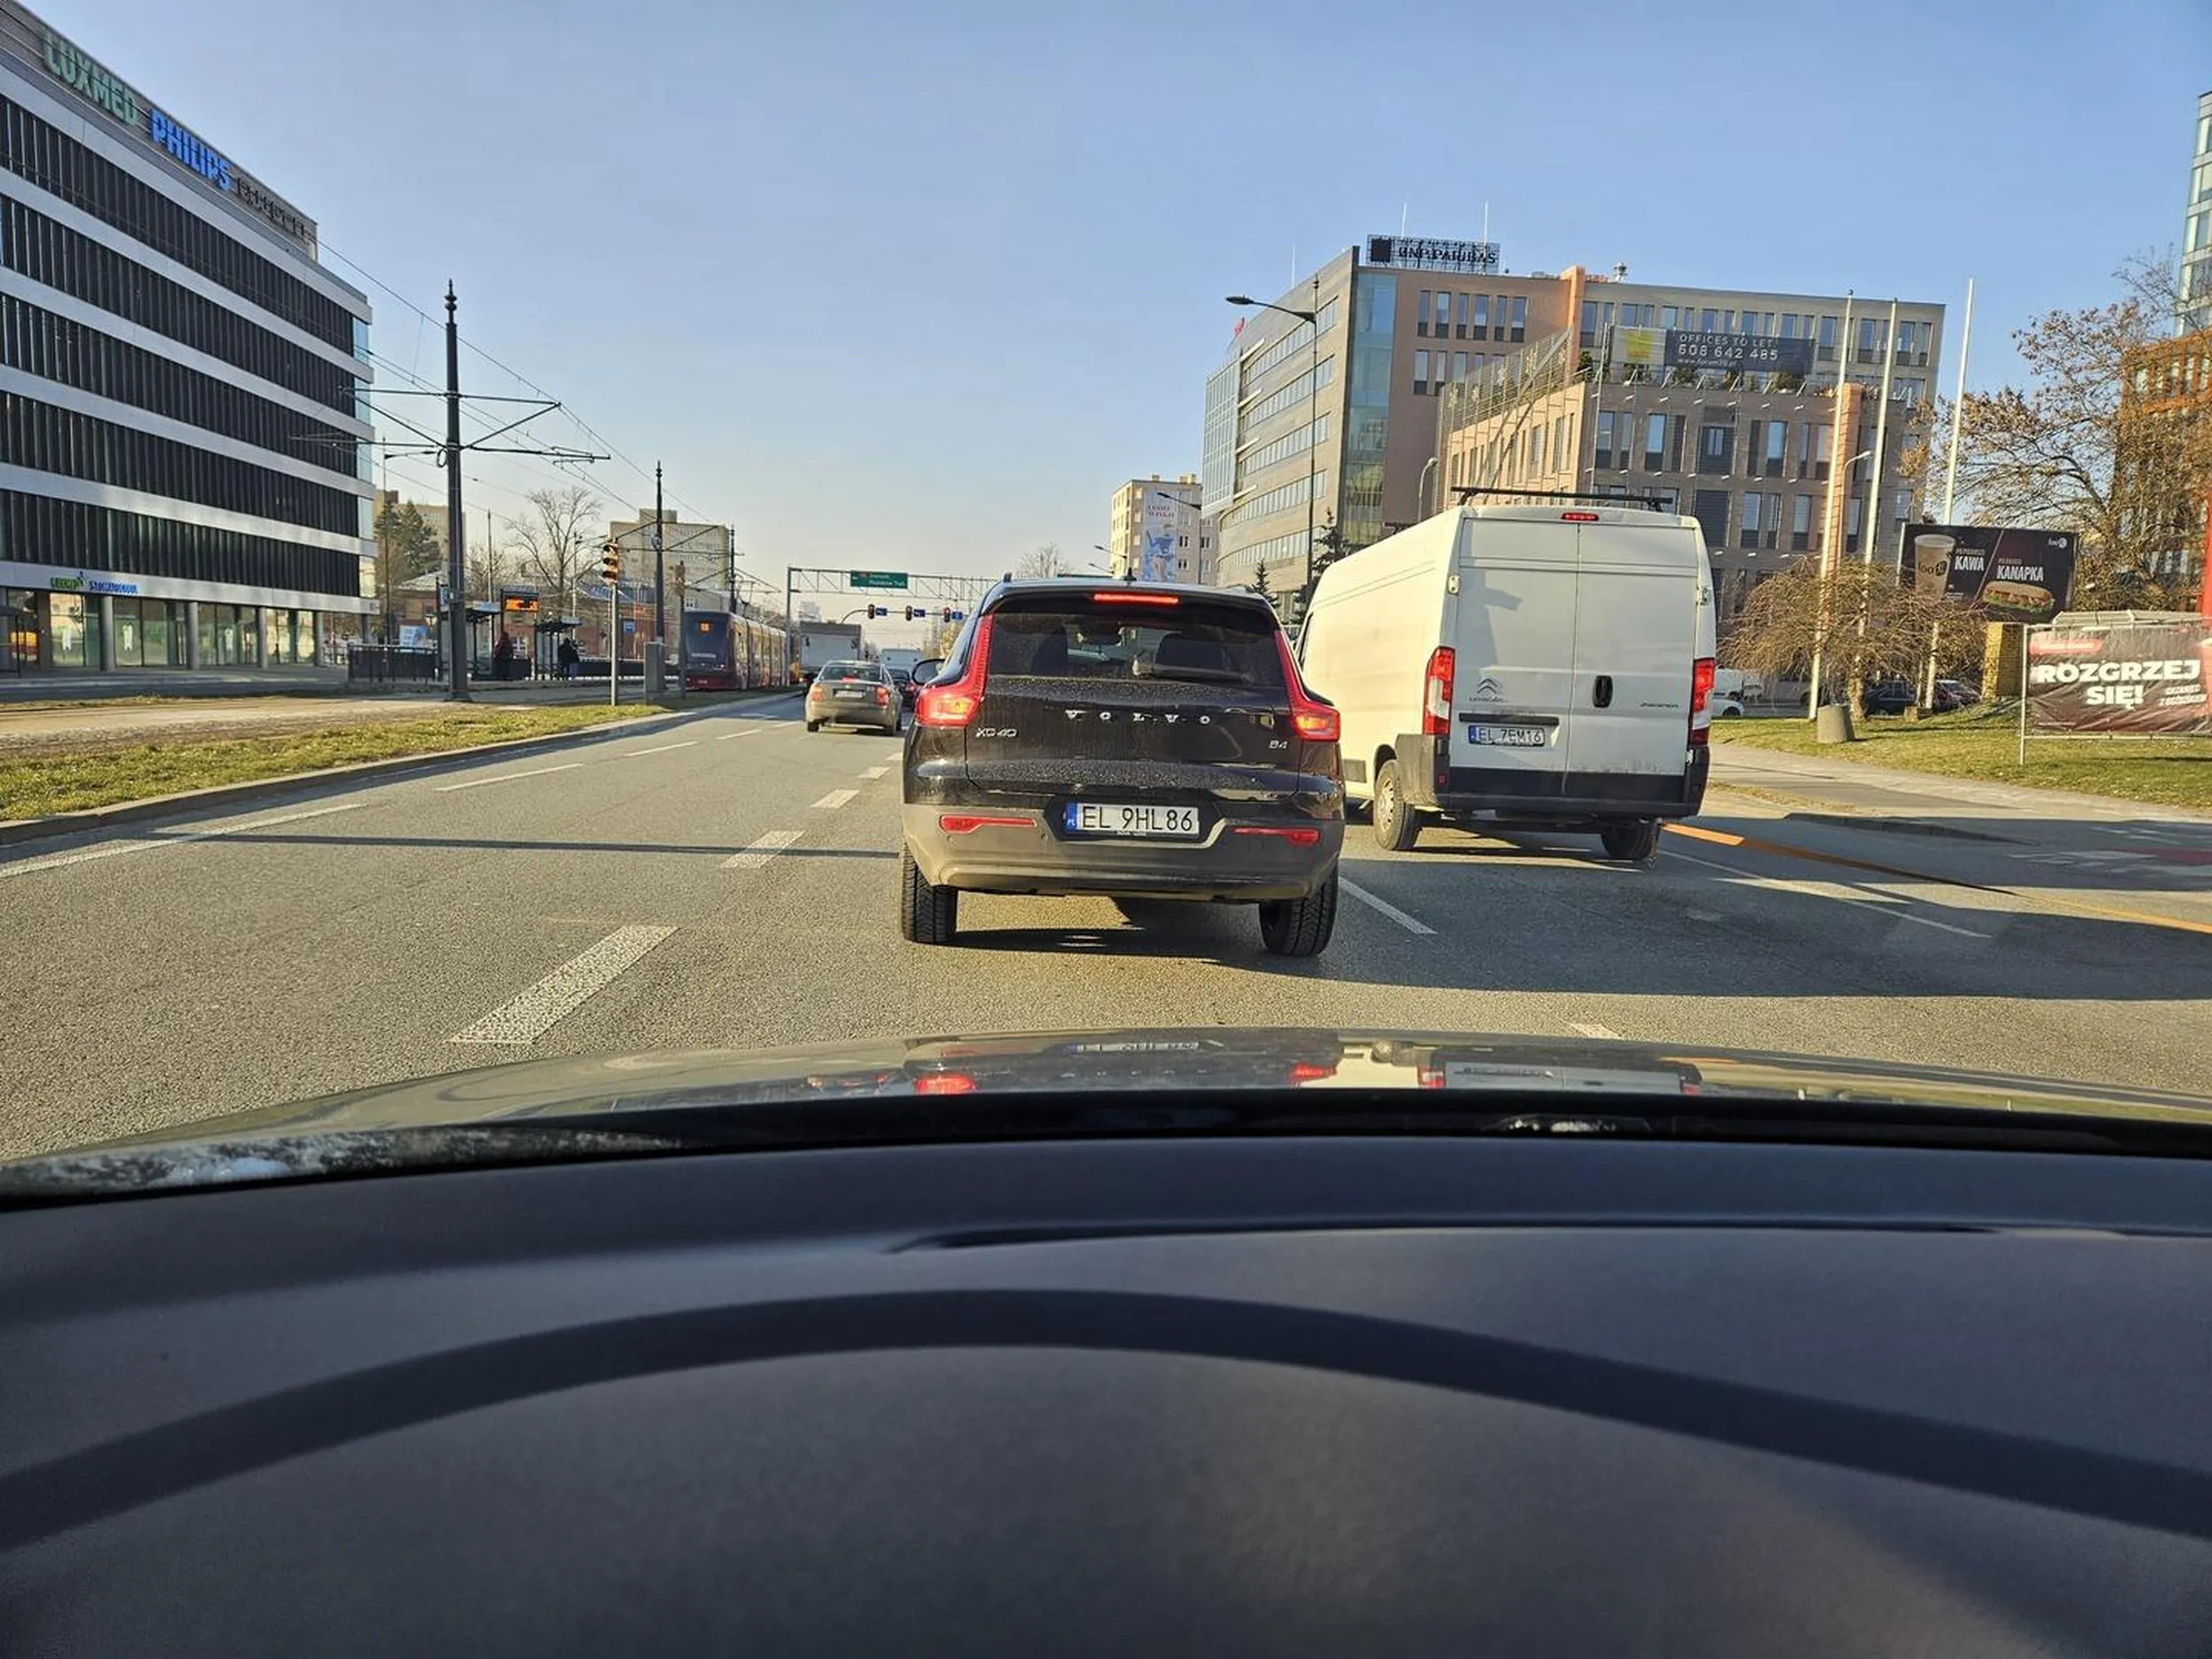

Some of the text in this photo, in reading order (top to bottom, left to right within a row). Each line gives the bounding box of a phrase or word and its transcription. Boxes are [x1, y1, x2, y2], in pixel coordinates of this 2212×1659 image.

[150, 108, 233, 191] PHILIPS
[1399, 247, 1496, 264] BNP PARIBAS
[1679, 334, 1729, 346] OFFICES
[1733, 336, 1748, 347] TO
[1678, 343, 1778, 362] 608 642 485
[1955, 556, 1985, 572] KAWA
[1996, 565, 2044, 581] KANAPKA
[2034, 659, 2200, 683] ROZGRZEJ
[2086, 685, 2145, 710] SIĘ!
[1065, 710, 1210, 726] VOLVO
[1082, 806, 1193, 832] EL 9HL86
